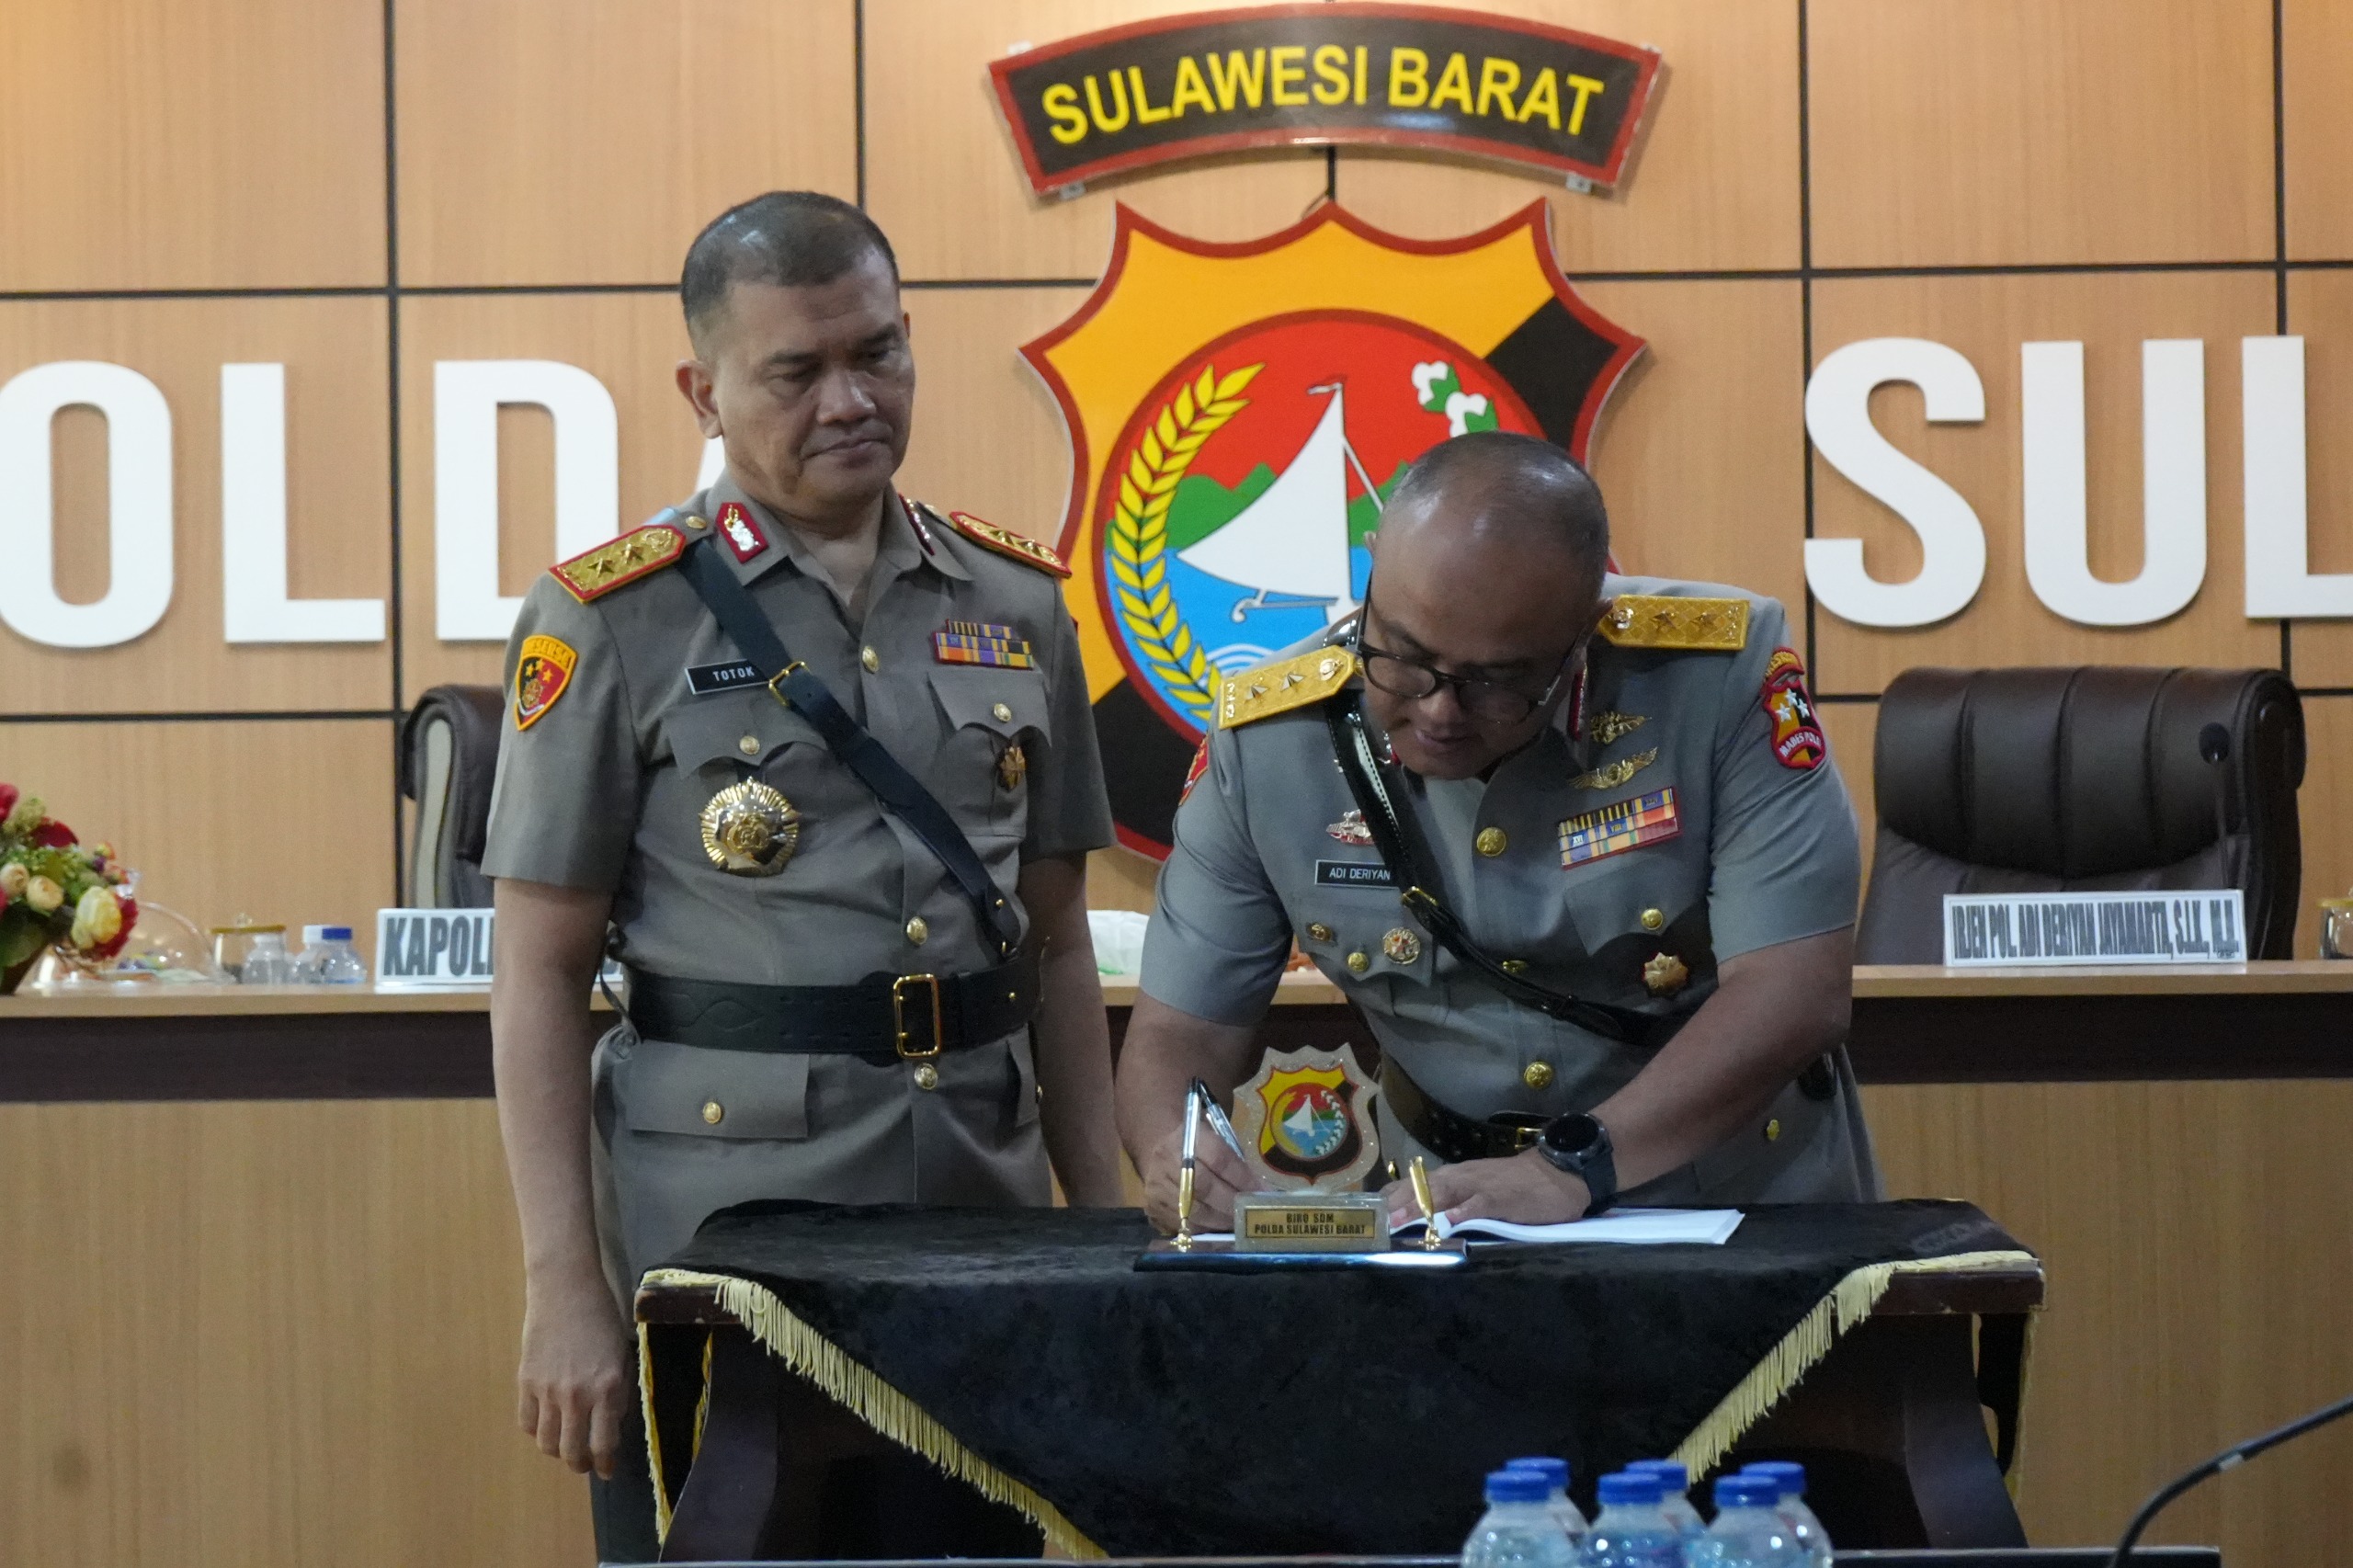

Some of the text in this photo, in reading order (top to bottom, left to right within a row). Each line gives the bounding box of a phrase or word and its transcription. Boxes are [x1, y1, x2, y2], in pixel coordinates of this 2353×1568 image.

[1041, 44, 1604, 144] SULAWESI BARAT
[0, 336, 2353, 647] OLD SUL
[712, 665, 755, 681] TOTOK
[1329, 868, 1391, 881] ADI DERIYAN
[1287, 1212, 1334, 1223] BIRO SDM
[1255, 1224, 1365, 1234] POLDA SULAWESI BARAT
